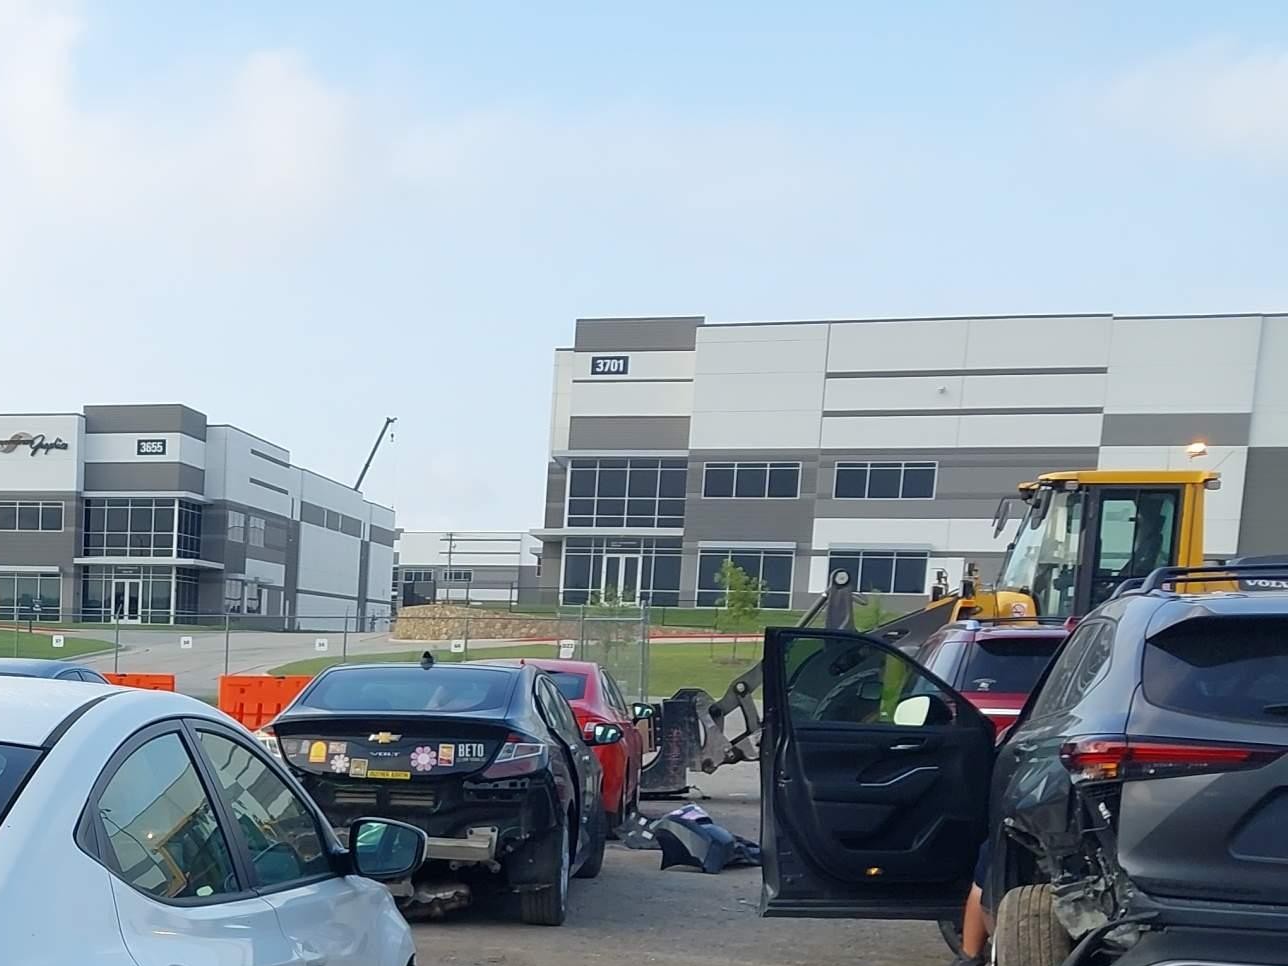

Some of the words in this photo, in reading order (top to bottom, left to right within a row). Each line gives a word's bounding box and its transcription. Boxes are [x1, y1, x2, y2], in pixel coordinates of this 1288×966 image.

[595, 359, 624, 372] 3701
[139, 441, 164, 453] 3655
[458, 743, 484, 757] BETO
